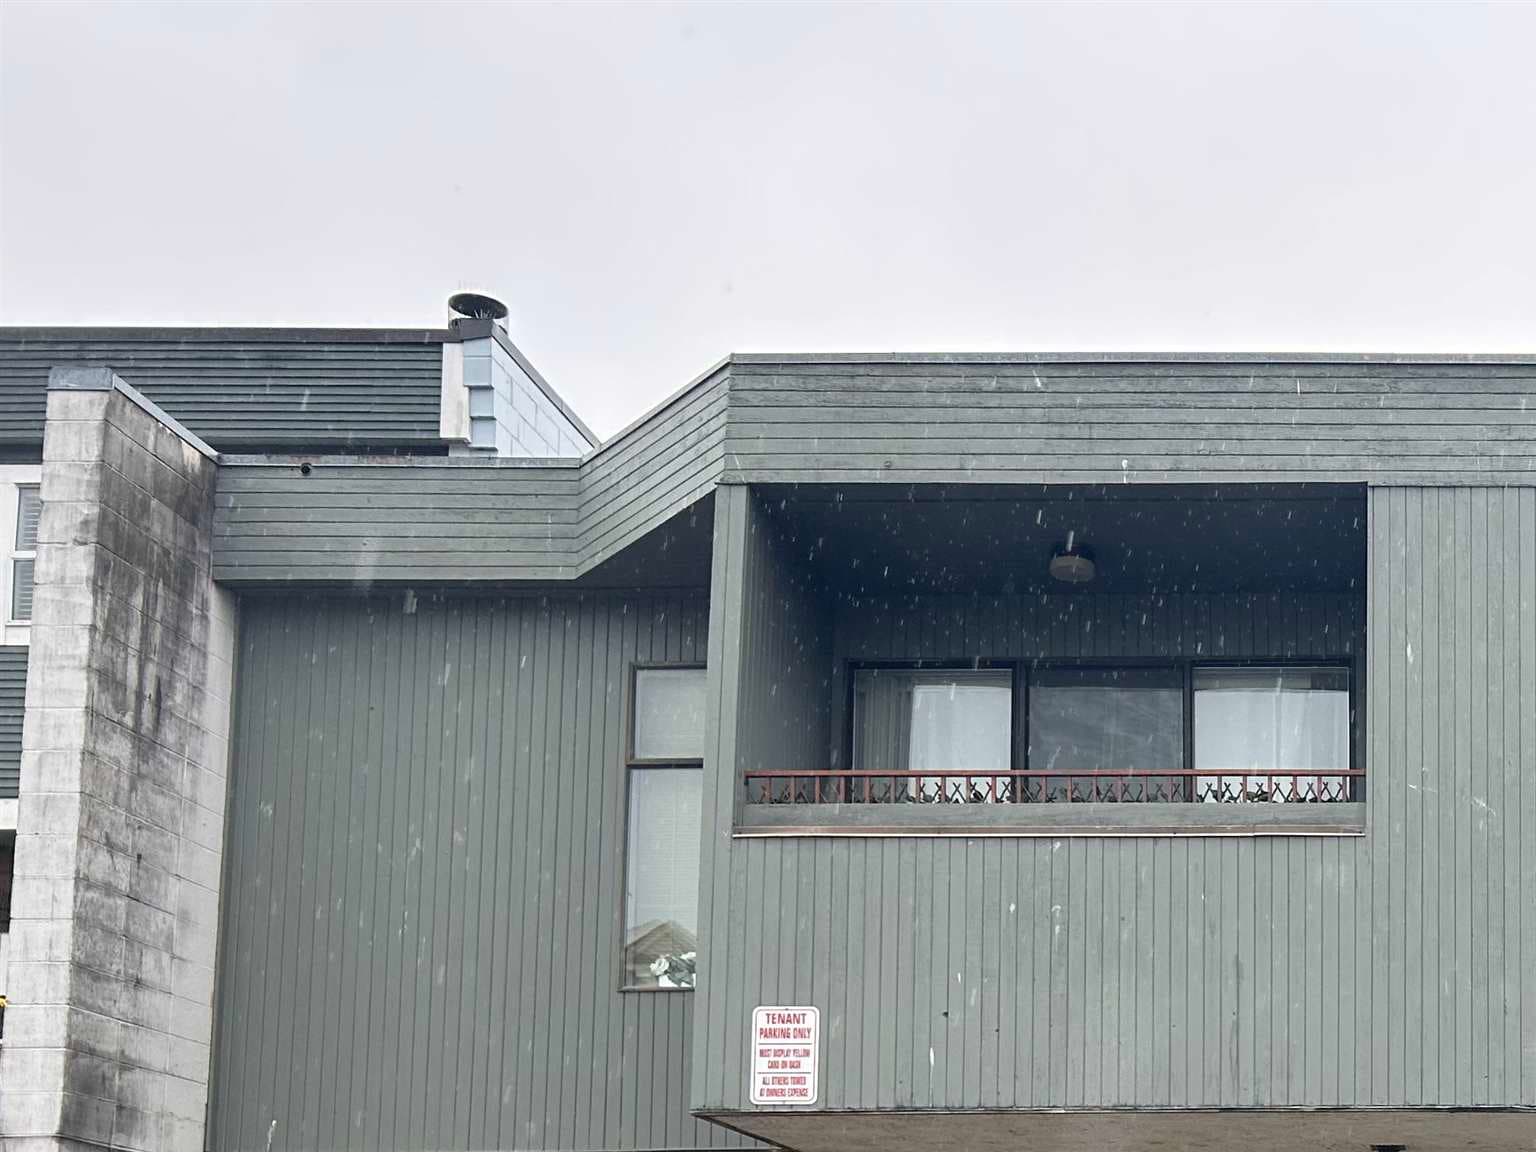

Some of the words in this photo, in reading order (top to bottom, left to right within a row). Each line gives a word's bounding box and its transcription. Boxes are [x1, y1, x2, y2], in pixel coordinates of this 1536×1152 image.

[766, 1013, 807, 1024] TENANT
[760, 1028, 791, 1039] PARKING
[793, 1027, 812, 1039] ONLY
